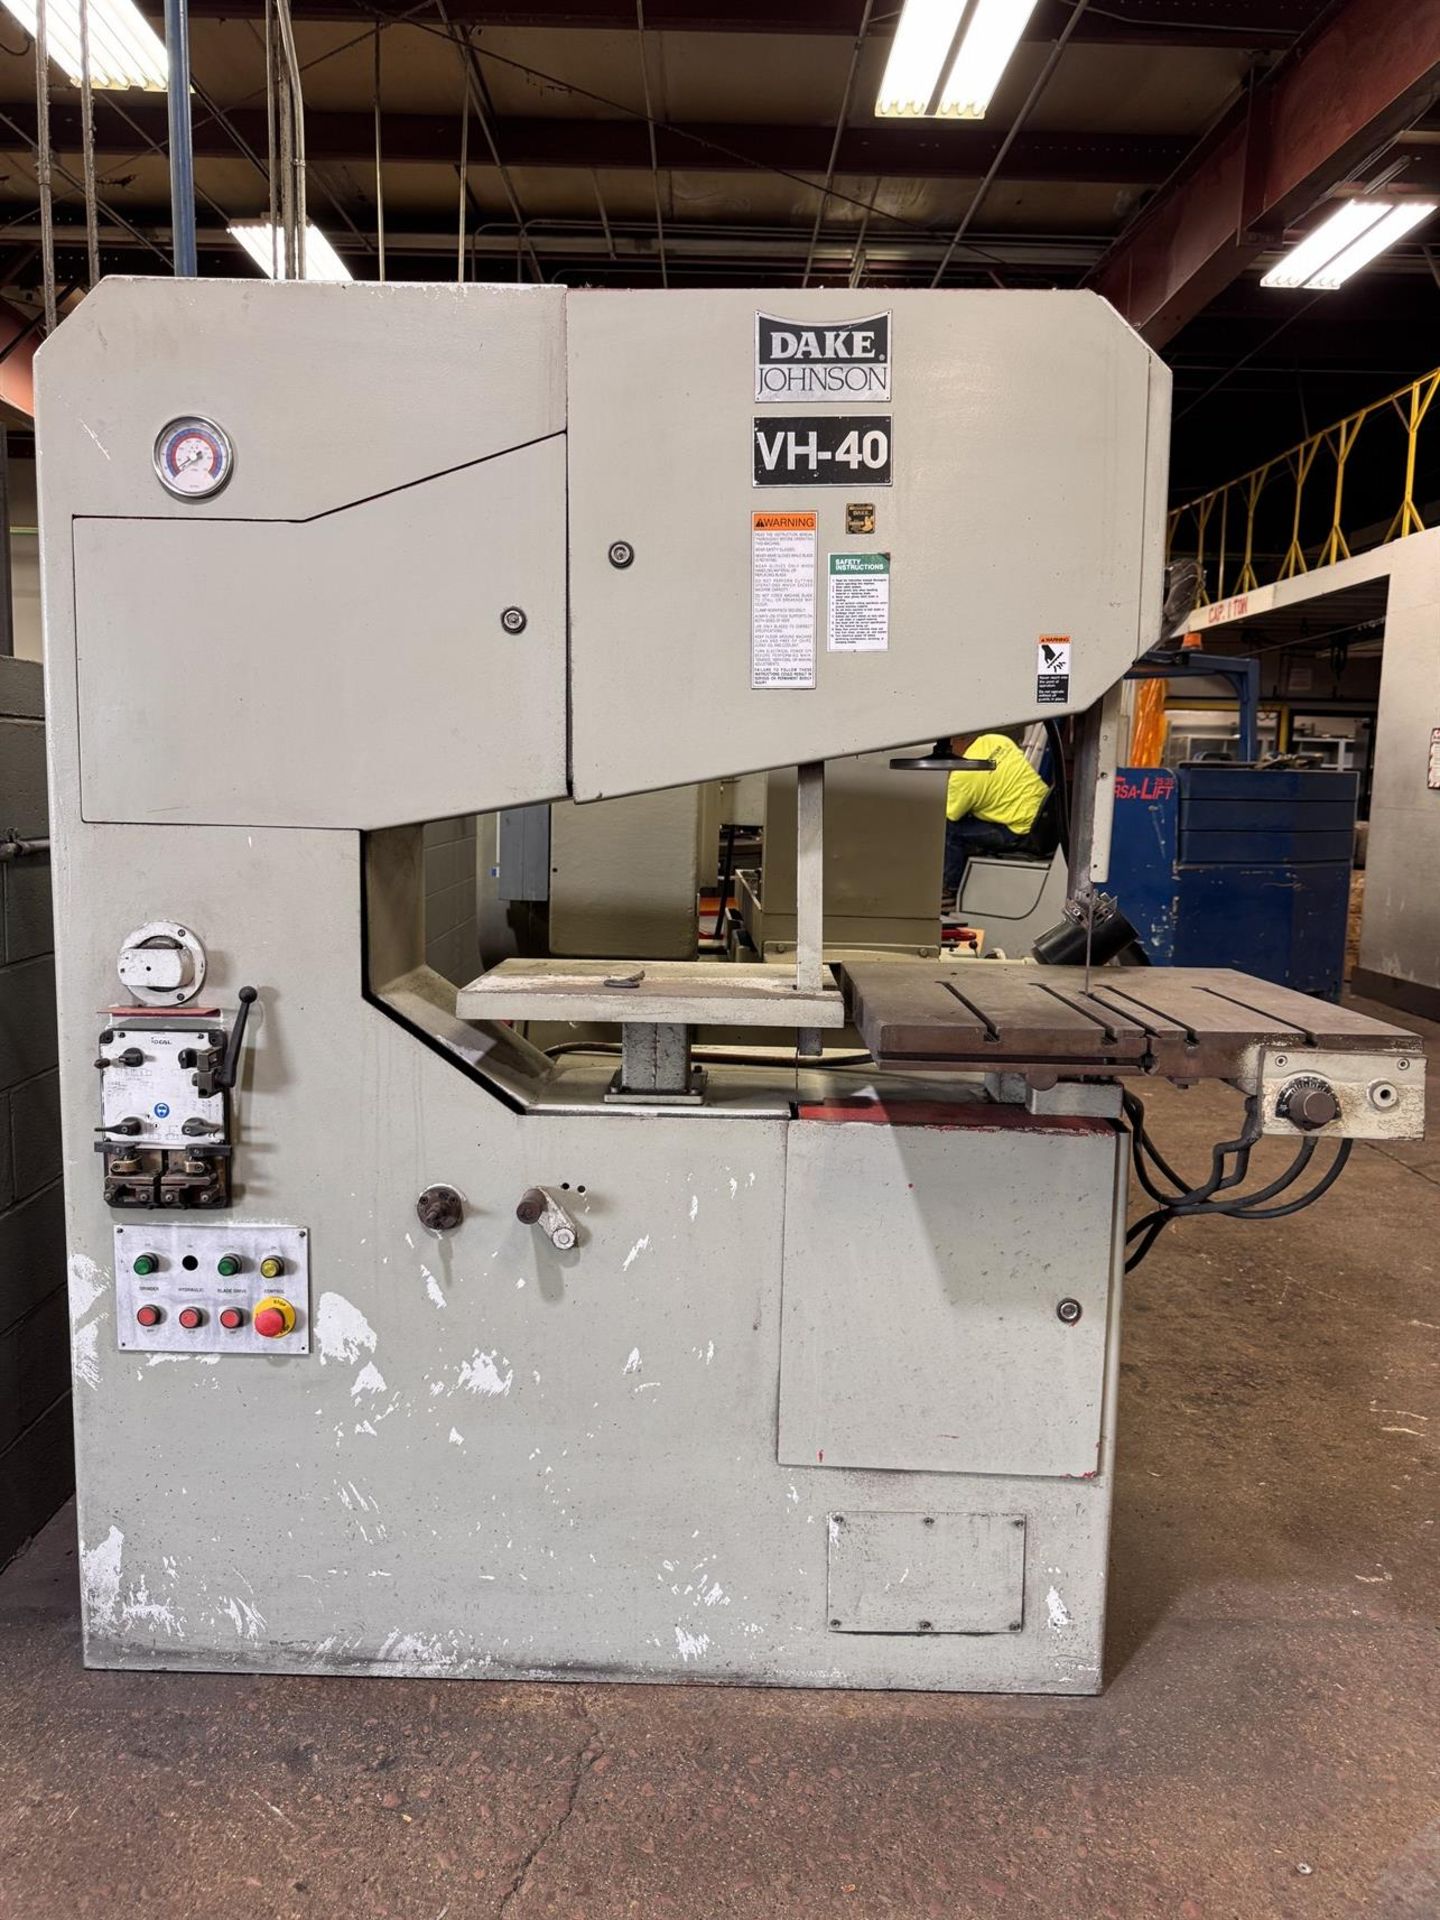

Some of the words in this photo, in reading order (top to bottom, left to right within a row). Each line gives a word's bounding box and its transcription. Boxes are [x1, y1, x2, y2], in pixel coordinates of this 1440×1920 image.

[769, 331, 876, 359] DAKE
[757, 366, 888, 395] JOHNSON
[756, 430, 889, 471] VH-40
[763, 517, 814, 528] WARNING
[1232, 596, 1249, 617] TON
